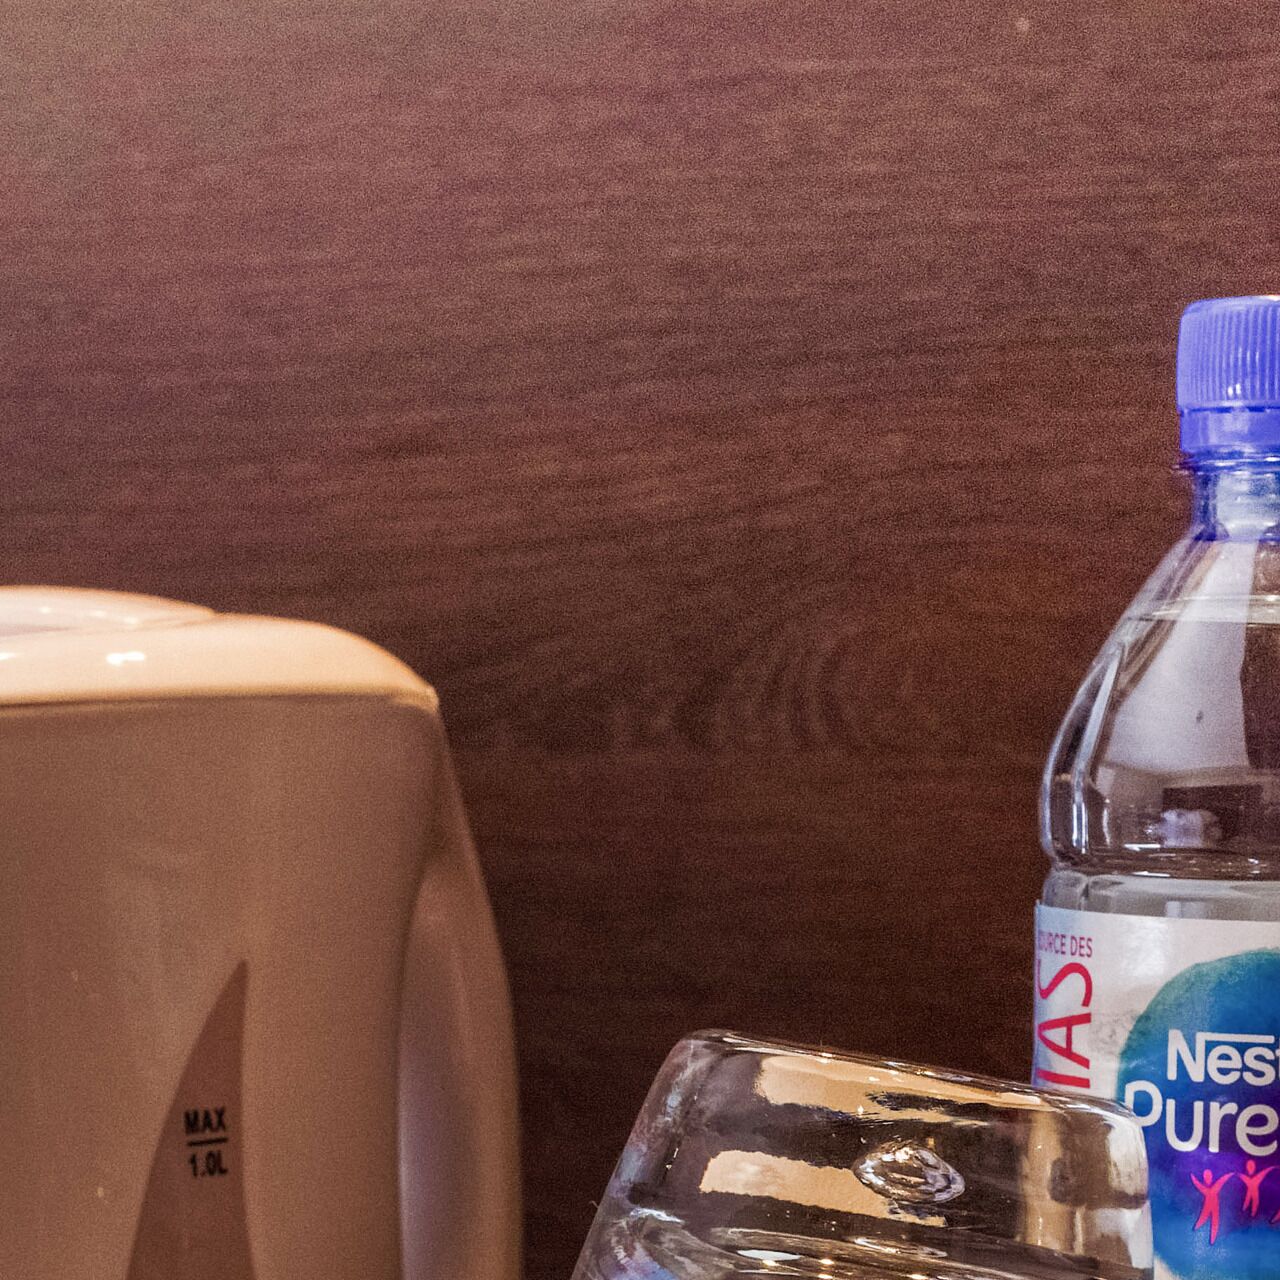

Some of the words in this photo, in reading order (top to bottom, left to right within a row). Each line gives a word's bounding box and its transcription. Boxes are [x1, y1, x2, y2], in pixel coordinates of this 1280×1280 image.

[1071, 936, 1093, 958] DES
[1036, 959, 1093, 1089] IAS
[184, 1106, 227, 1136] MAX
[1124, 1080, 1279, 1157] Pure
[189, 1150, 228, 1177] 1.0L
